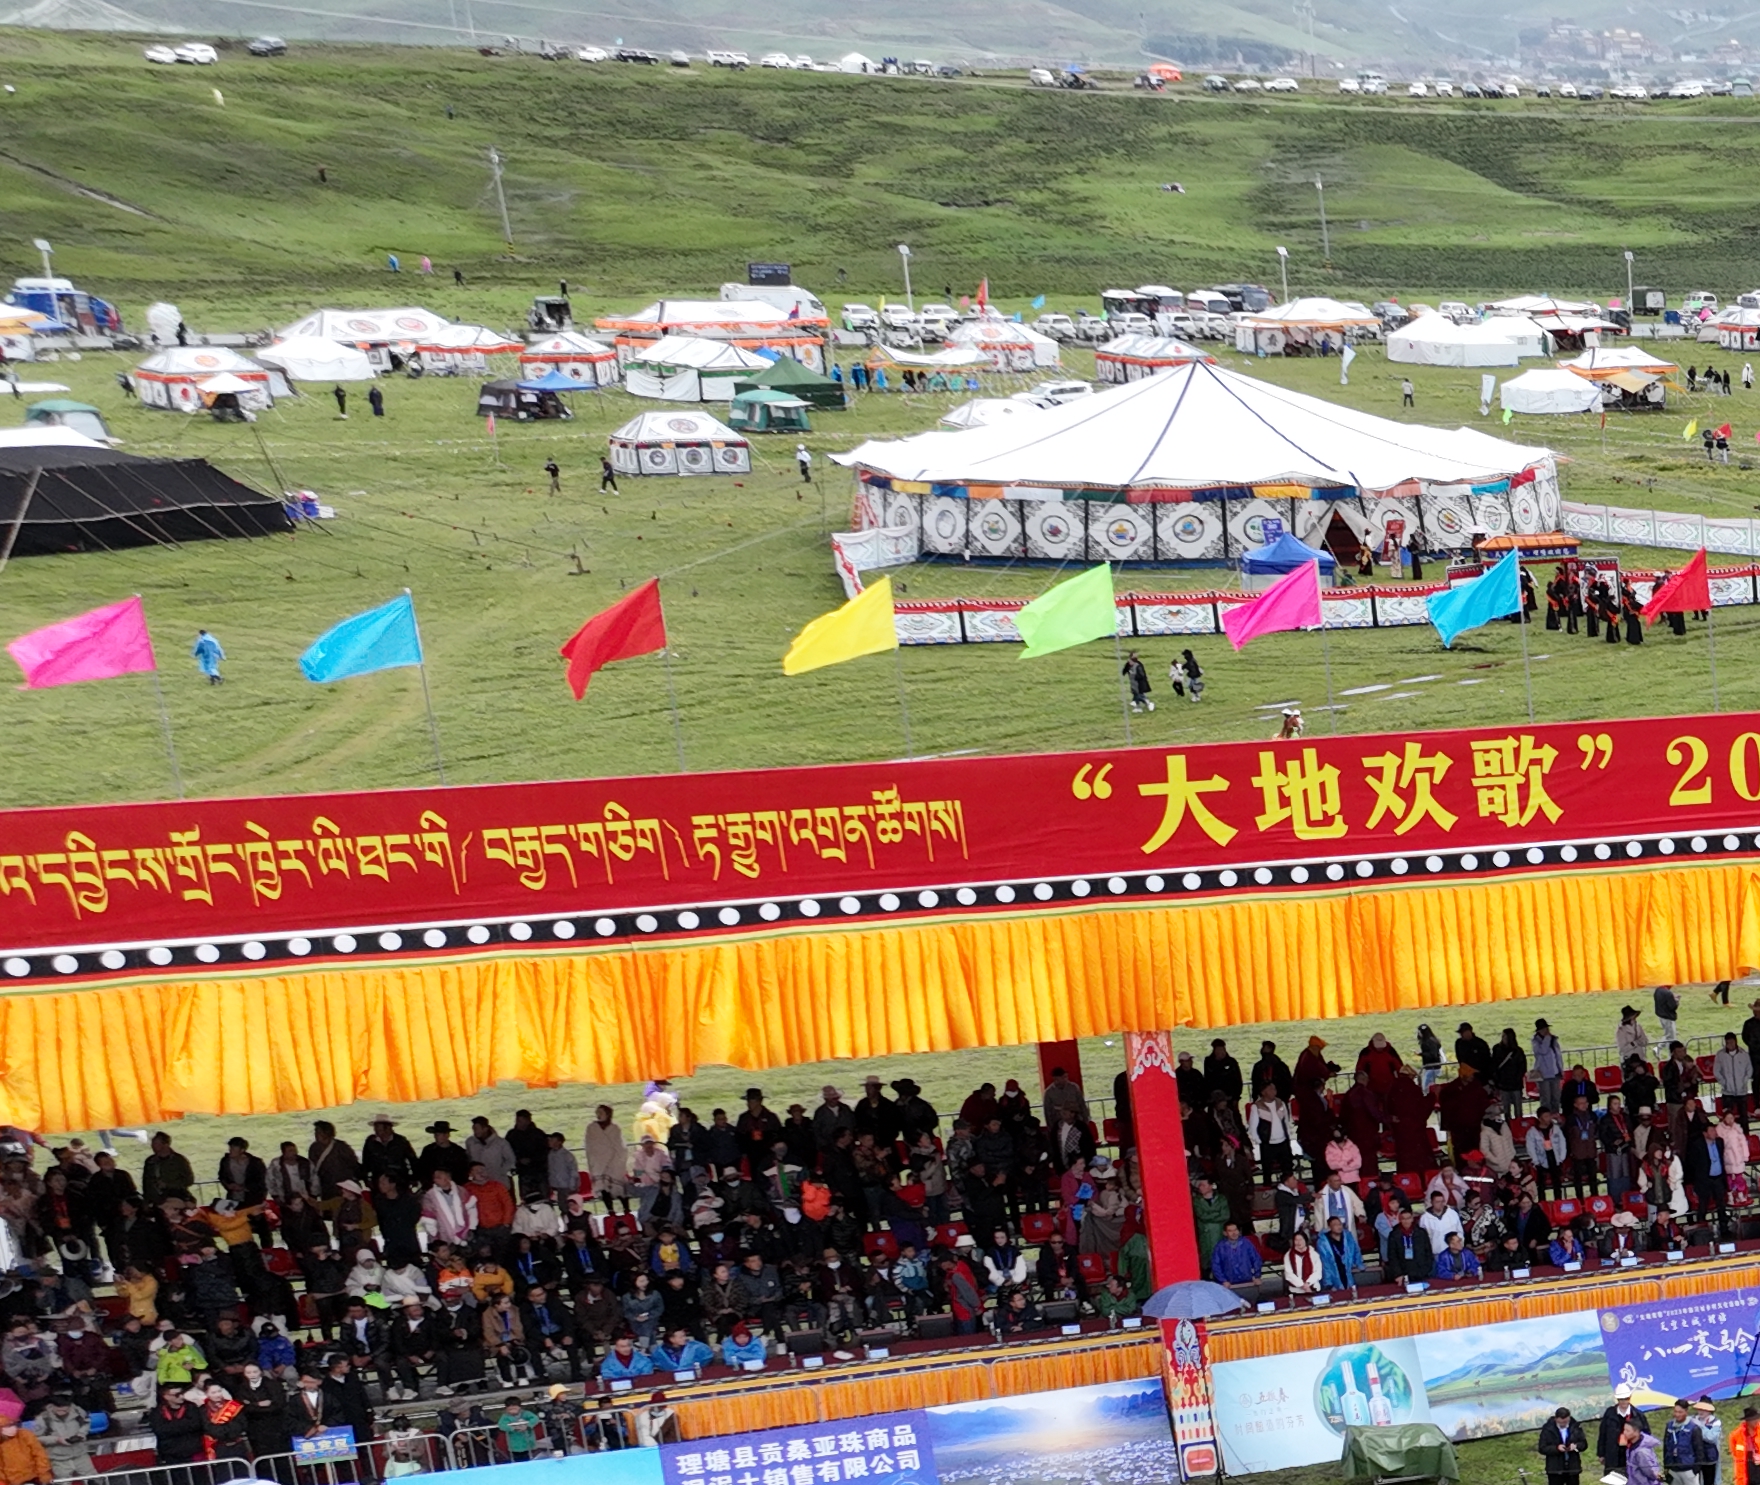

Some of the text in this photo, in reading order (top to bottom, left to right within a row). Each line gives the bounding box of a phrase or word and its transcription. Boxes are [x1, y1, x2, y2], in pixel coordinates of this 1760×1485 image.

[676, 1424, 917, 1475] 理塘县贡桑亚珠商品
